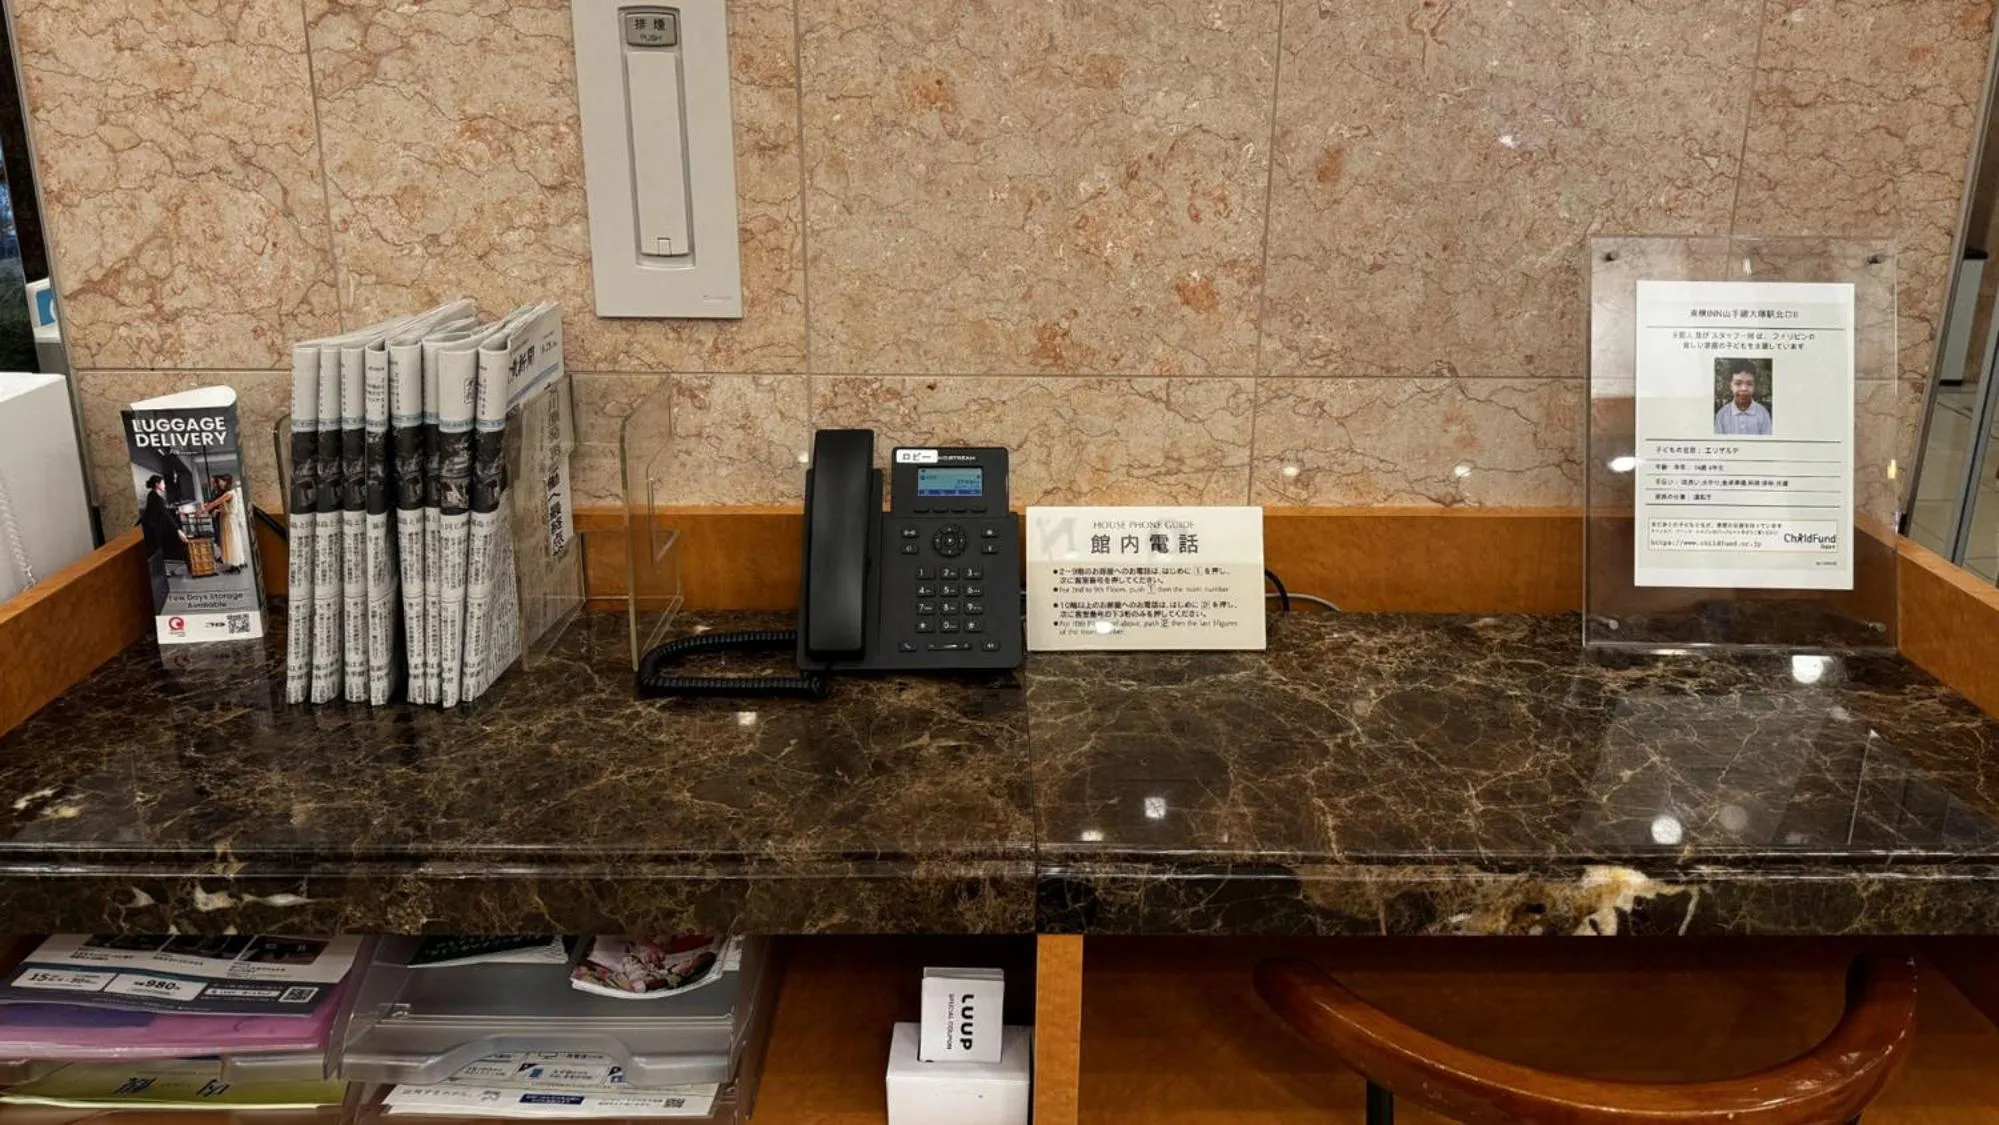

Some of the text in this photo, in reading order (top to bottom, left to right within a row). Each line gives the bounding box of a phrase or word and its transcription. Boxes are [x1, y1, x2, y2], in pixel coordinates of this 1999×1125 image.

[132, 417, 226, 432] LUGGAGE
[135, 431, 227, 447] DELIVERY
[902, 452, 932, 461] ロビー
[1093, 520, 1194, 529] HOUSE PHONE GUIDE
[1091, 534, 1198, 553] 館内電話
[1784, 532, 1836, 545] ChildFund
[187, 593, 208, 602] Days
[210, 592, 244, 601] Storage
[188, 601, 227, 609] Available
[960, 994, 975, 1050] LUUP
